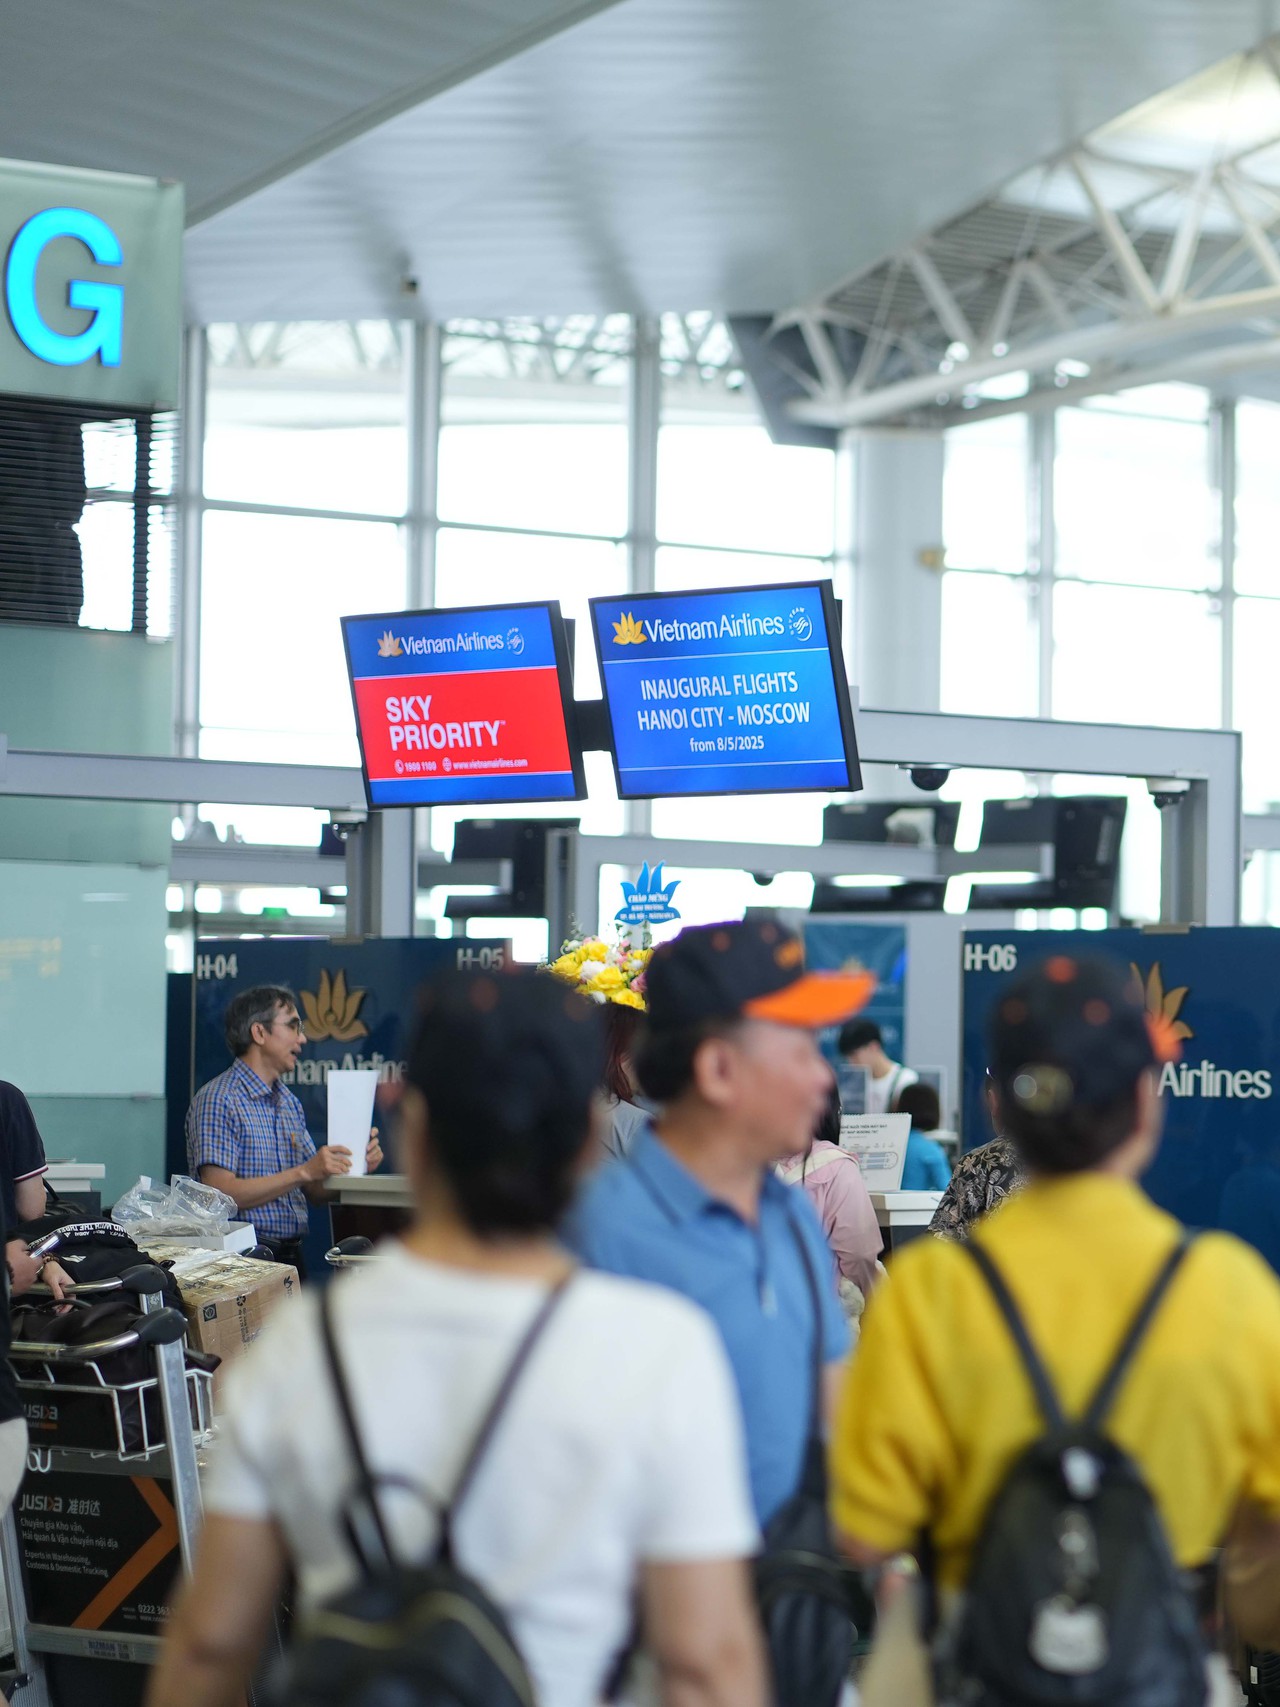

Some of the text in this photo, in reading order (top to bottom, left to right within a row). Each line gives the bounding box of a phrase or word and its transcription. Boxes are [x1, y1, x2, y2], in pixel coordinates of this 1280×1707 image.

[6, 206, 124, 367] G
[644, 612, 785, 643] Vietnam Airlines
[401, 635, 455, 656] Vietnam
[455, 631, 504, 652] Airlines
[640, 671, 799, 701] INAUGURAL FLIGHTS
[385, 695, 432, 723] SKY
[637, 707, 689, 731] HANOI
[690, 706, 724, 729] CITY
[737, 701, 810, 727] MOSCOW
[690, 735, 765, 753] from 8/5/2025
[197, 953, 239, 980] H-04
[456, 947, 504, 972] H-05
[963, 943, 1017, 972] H-06
[1157, 1060, 1272, 1099] Airlines
